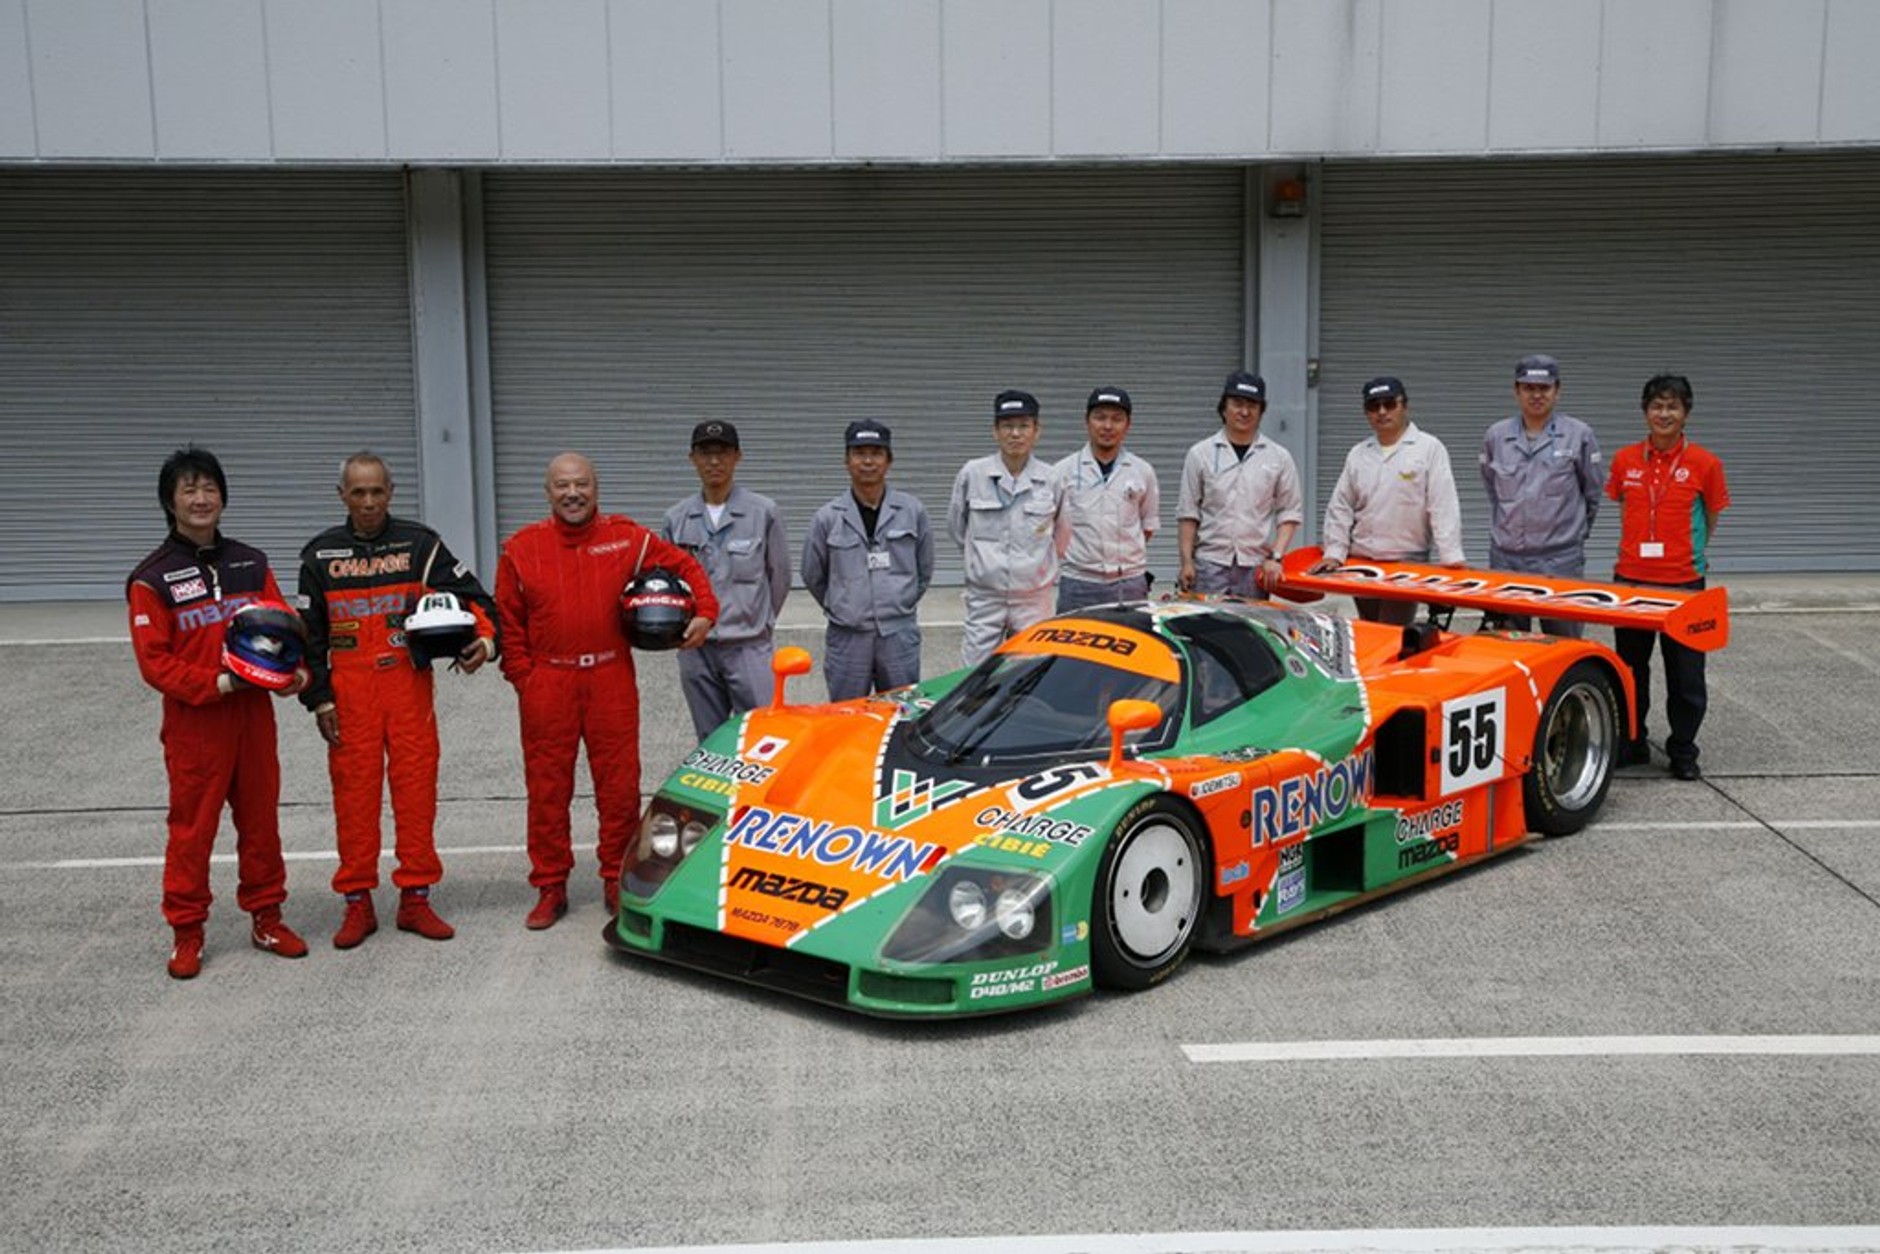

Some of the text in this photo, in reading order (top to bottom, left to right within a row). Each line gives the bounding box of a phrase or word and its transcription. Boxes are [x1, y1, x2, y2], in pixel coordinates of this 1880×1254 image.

[328, 552, 412, 578] CHARGE
[1028, 629, 1138, 656] mazda
[1449, 701, 1496, 777] 55
[974, 805, 1096, 848] CHARGE
[1395, 800, 1464, 845] CHARGE
[723, 806, 933, 882] RENOWN
[1398, 832, 1459, 870] mazda
[730, 866, 849, 912] mazda
[732, 906, 770, 923] MAZDA
[970, 961, 1059, 986] DUNLOP
